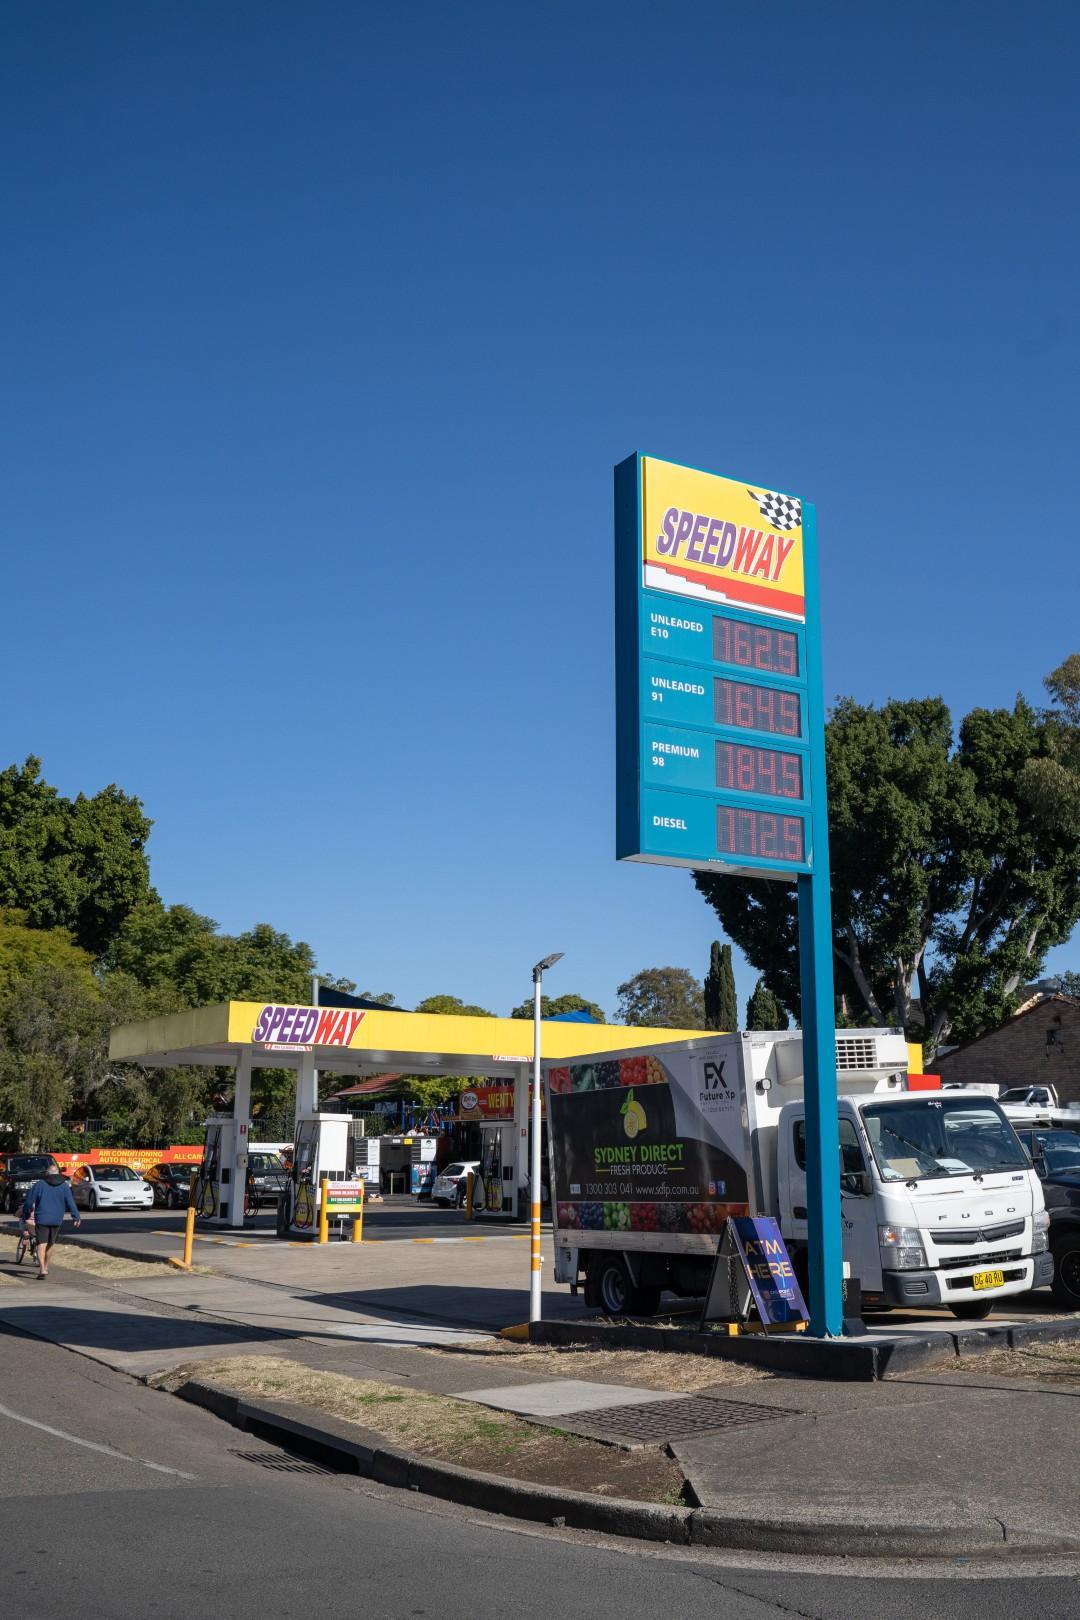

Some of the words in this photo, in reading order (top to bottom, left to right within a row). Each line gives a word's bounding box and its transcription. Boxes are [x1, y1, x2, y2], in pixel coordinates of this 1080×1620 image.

[656, 507, 796, 582] SPEEDWAY
[651, 613, 704, 632] UNLEADED
[651, 628, 669, 639] E10
[720, 620, 796, 675] 162.5
[651, 676, 705, 695] UNLEADED
[651, 691, 663, 702] 91
[722, 682, 798, 736] 164.5
[652, 741, 700, 759] PREMIUM
[652, 756, 665, 767] 98
[653, 815, 687, 830] DIESEL
[254, 1005, 365, 1046] SPEEDWAY
[703, 1060, 728, 1090] FX
[699, 1092, 724, 1101] Future
[594, 1146, 637, 1163] SYDNEY
[640, 1144, 684, 1162] DIRECT
[610, 1165, 631, 1175] FRESH
[631, 1164, 668, 1175] PRODUCE
[586, 1183, 602, 1195] 1300
[603, 1183, 617, 1194] 303
[619, 1182, 634, 1194] 041
[938, 1207, 1016, 1221] FUSO
[745, 1239, 783, 1256] ATM
[746, 1261, 793, 1280] HERE
